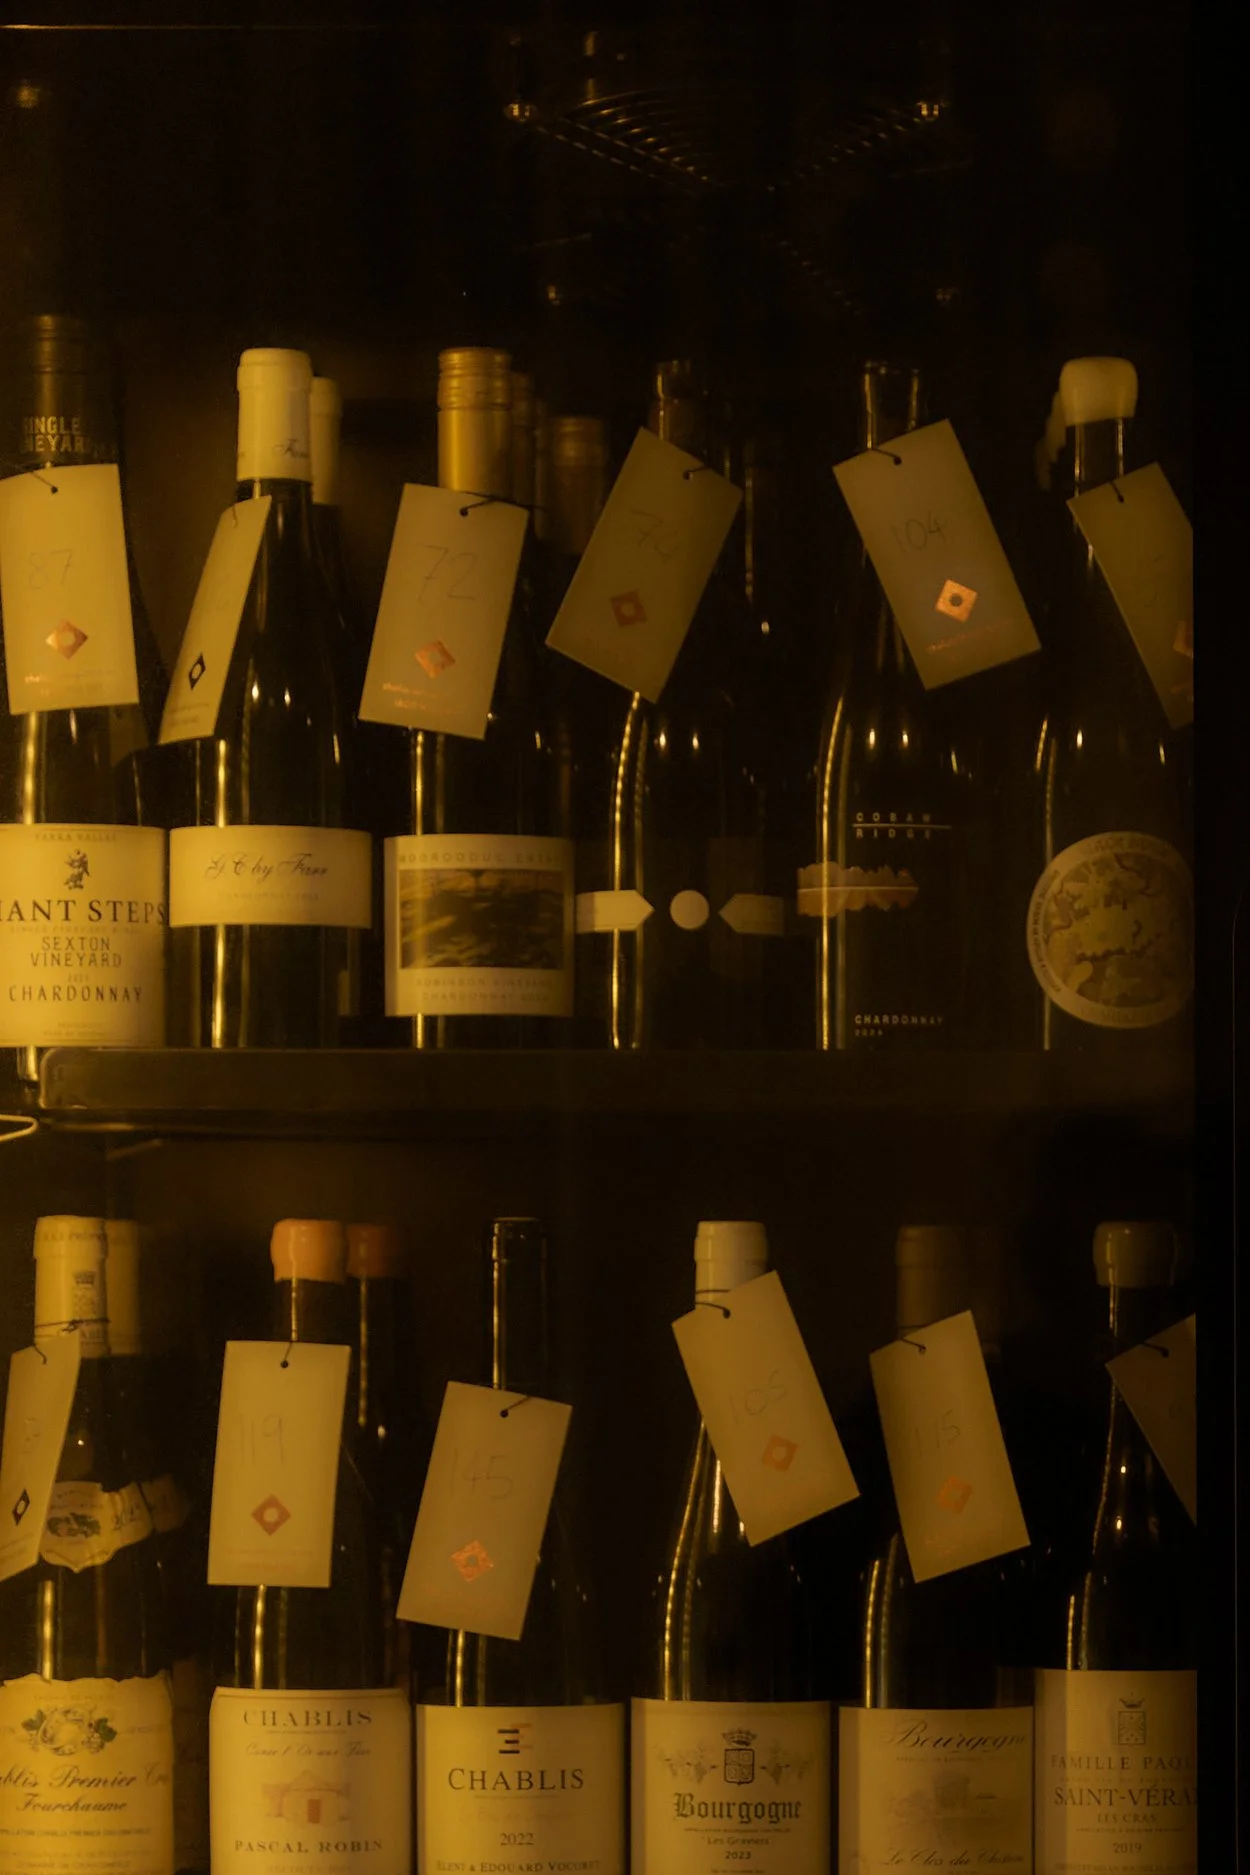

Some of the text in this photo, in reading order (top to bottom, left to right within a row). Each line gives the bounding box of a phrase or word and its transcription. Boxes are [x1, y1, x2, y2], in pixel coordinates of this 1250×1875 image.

[27, 549, 73, 592] 87
[416, 544, 479, 601] 72
[854, 811, 930, 823] COBAW
[0, 898, 165, 926] ANT STEPS
[40, 935, 112, 952] SEXTON
[29, 952, 123, 968] VINEYARD
[7, 984, 143, 1003] CHARDONNAY
[243, 1708, 373, 1728] CHABLIS
[1051, 1755, 1131, 1771] FAMILLE
[0, 1764, 137, 1789] blis Premier
[447, 1767, 585, 1792] CHABLIS
[16, 1792, 128, 1812] Fourchaume
[671, 1791, 802, 1825] Bourgogne
[1096, 1813, 1118, 1824] LES
[235, 1838, 383, 1854] PASCAL ROBIN
[499, 1831, 535, 1848] 2022
